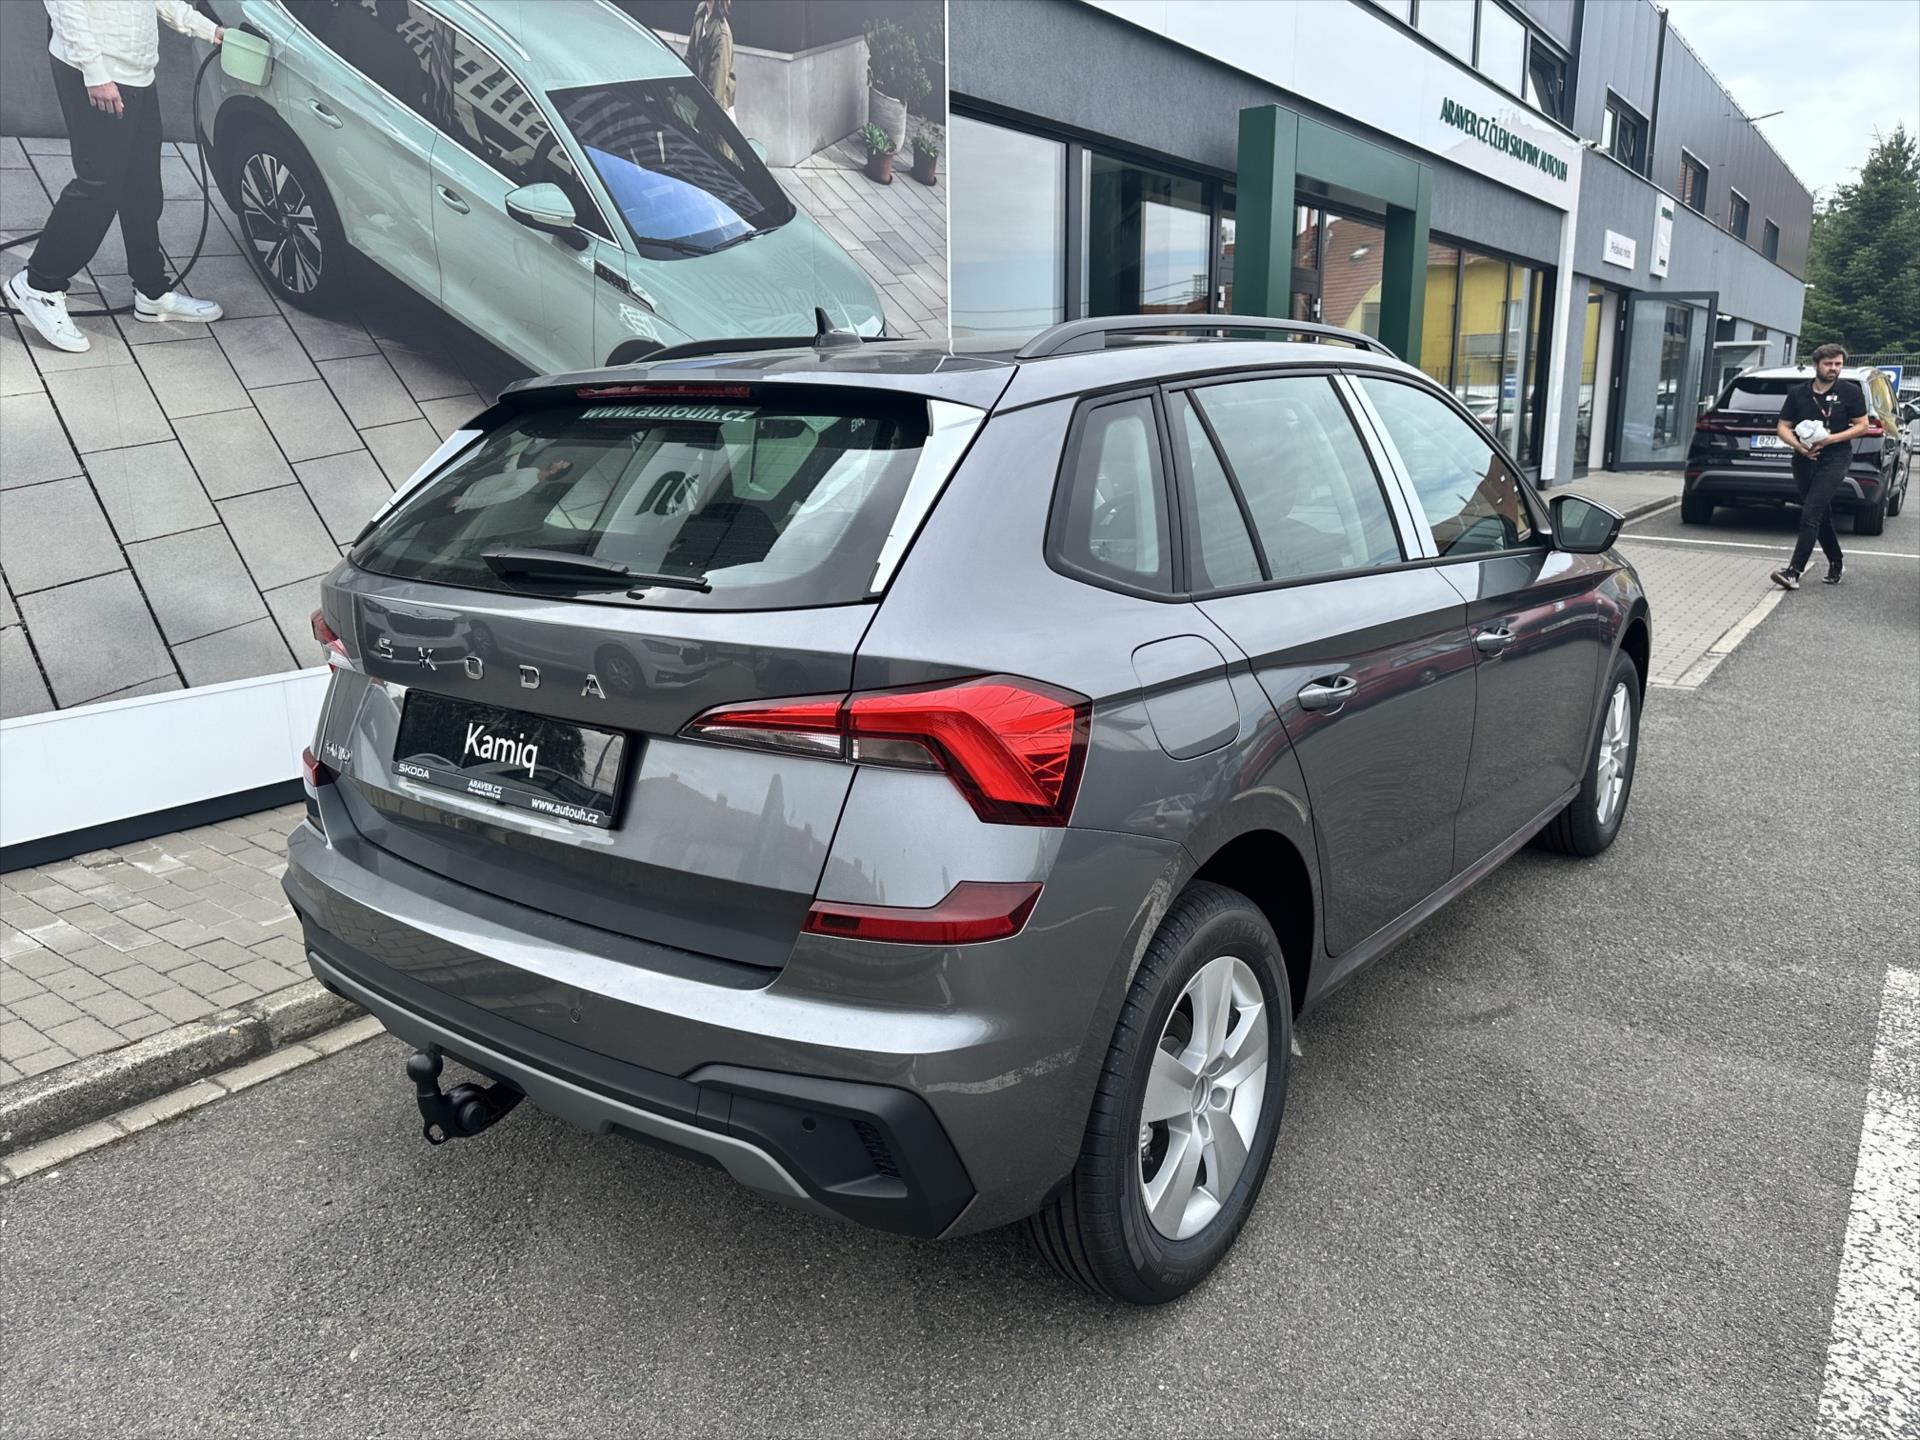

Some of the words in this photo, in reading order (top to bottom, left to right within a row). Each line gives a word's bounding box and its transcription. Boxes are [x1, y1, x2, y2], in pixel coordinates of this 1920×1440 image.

[1440, 96, 1477, 137] ARAVER
[1477, 117, 1490, 142] CZ
[1489, 117, 1511, 154] ČLEN
[1509, 134, 1541, 167] SKUPINY
[581, 404, 756, 423] www.autouh.cz
[464, 722, 539, 779] Kamiq
[468, 779, 493, 792] ARAVER
[493, 785, 503, 794] CZ
[531, 798, 599, 824] www.autouh.cz
